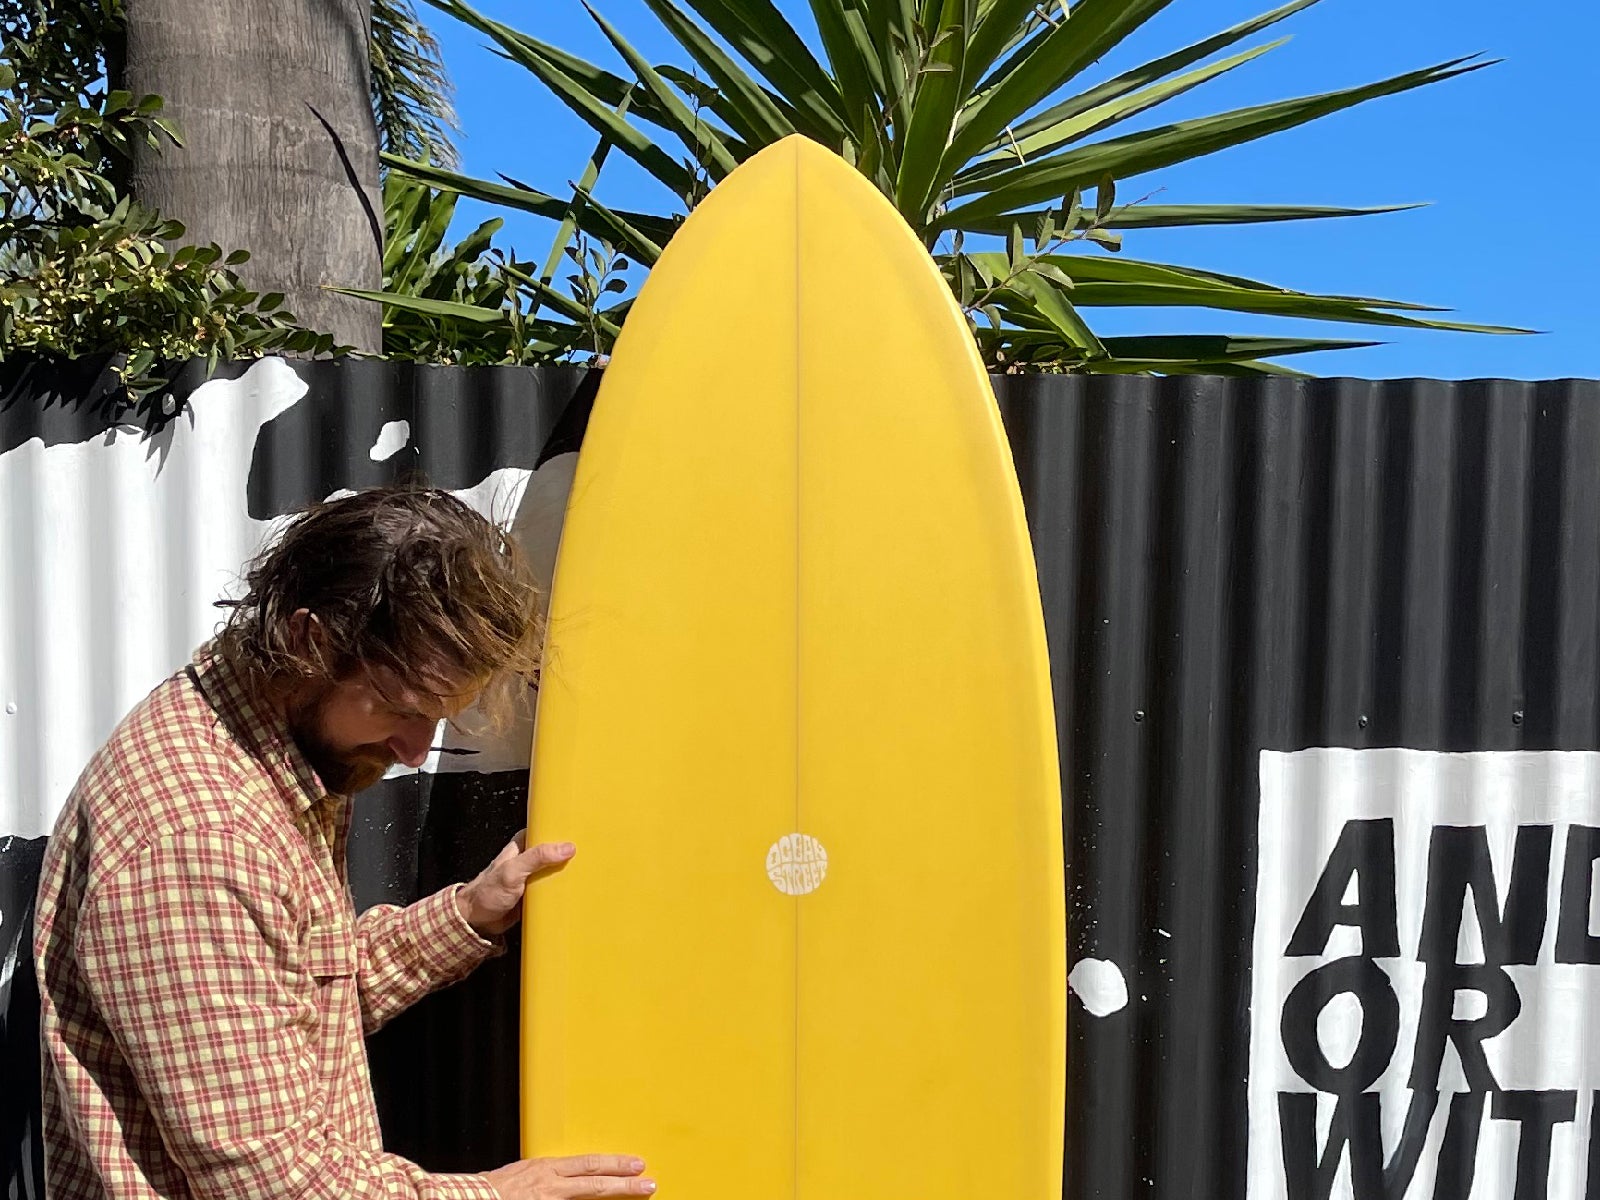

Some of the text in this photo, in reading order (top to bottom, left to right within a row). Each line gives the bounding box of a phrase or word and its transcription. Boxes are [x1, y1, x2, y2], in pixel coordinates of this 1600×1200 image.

[766, 833, 828, 871] OCEAN
[767, 860, 828, 895] STREET
[1281, 955, 1521, 1093] OR
